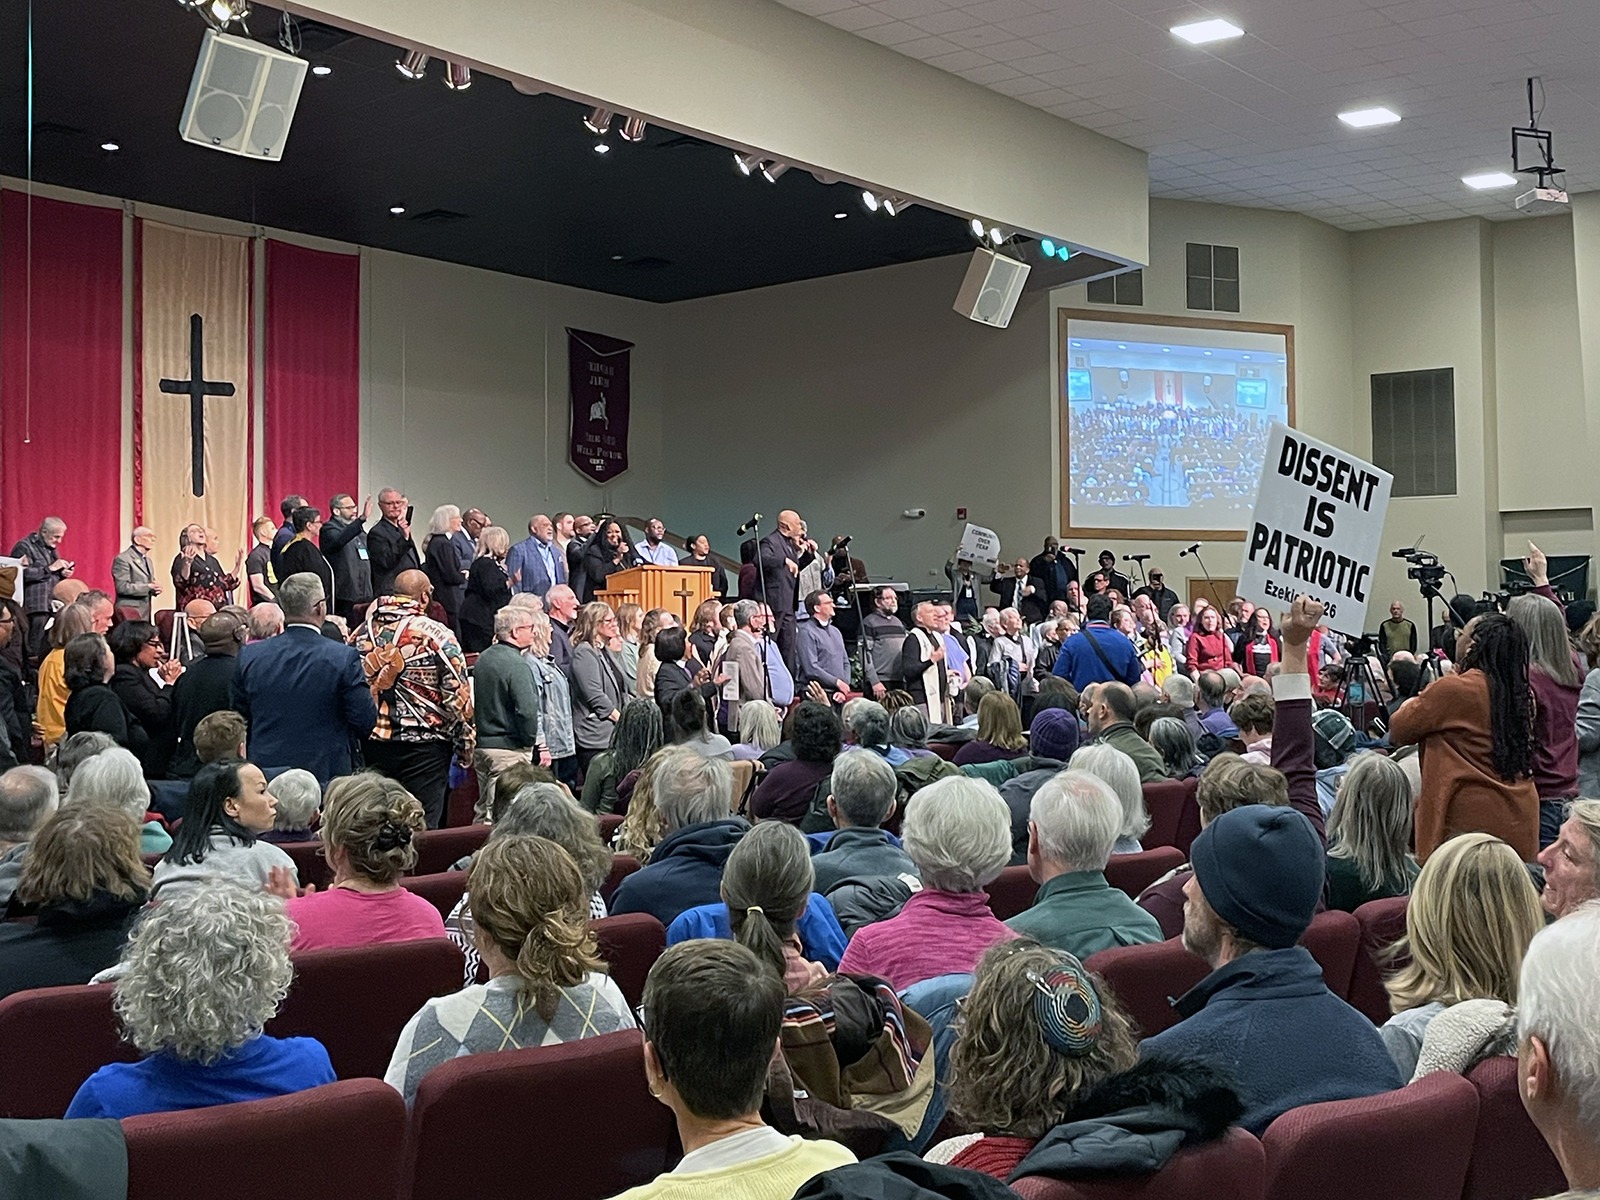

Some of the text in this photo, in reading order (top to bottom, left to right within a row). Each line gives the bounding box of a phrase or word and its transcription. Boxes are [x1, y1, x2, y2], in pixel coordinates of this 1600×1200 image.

[1277, 435, 1380, 512] DISSENT
[1302, 495, 1336, 538] IS
[1248, 522, 1370, 603] PATRIOTIC
[1264, 580, 1305, 604] Ezeki
